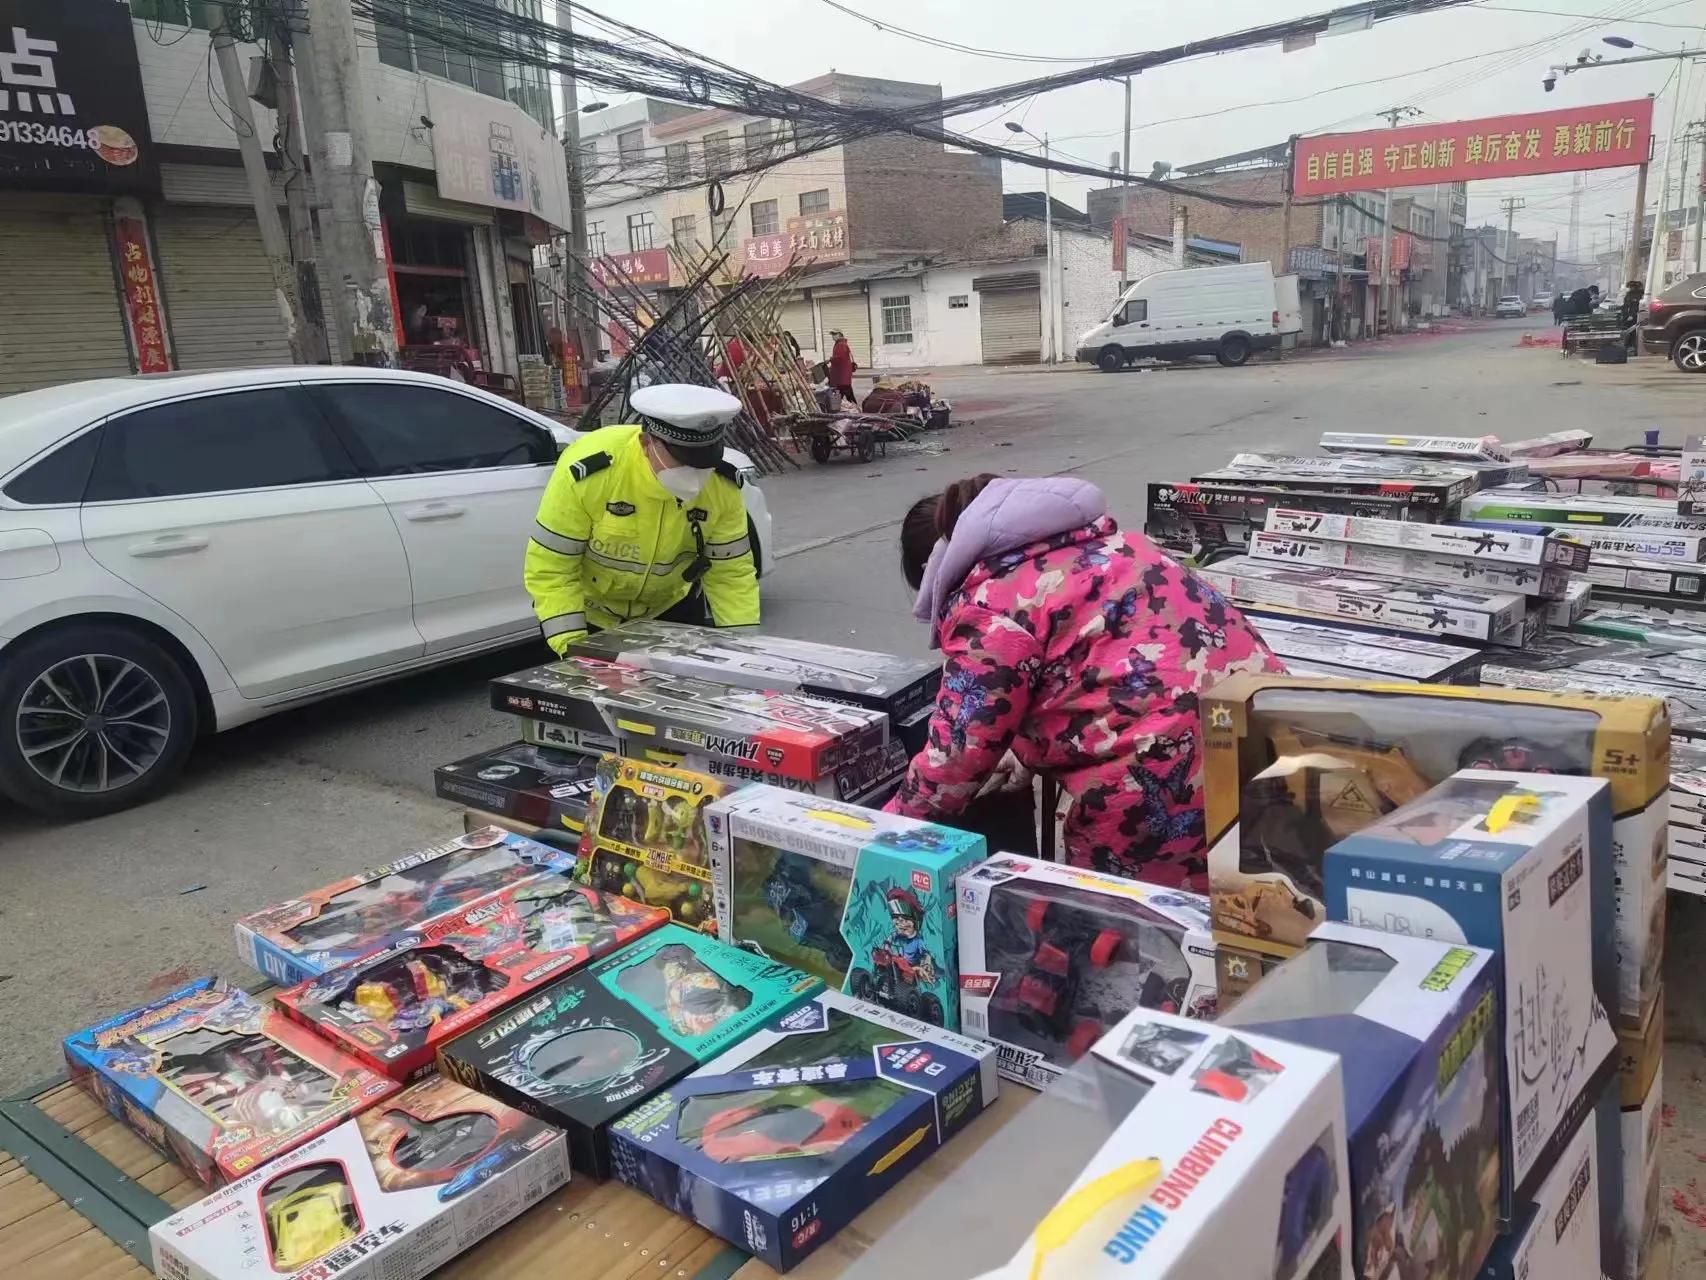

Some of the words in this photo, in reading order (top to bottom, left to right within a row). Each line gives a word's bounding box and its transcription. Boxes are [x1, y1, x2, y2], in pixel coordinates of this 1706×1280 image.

[0, 26, 76, 115] 点
[1306, 148, 1374, 182] 自信自强
[1383, 138, 1457, 175] 守正创新
[1465, 128, 1542, 165] 踔厉奋发
[1552, 117, 1638, 158] 勇毅前行
[1177, 490, 1214, 505] AK47
[704, 733, 763, 763] AWM
[1602, 749, 1640, 766] 5+
[708, 760, 764, 783] 突击步枪
[768, 774, 816, 794] M416
[711, 841, 725, 852] 6+
[912, 873, 930, 886] R/C
[964, 976, 992, 989] 合金版
[640, 1122, 671, 1143] 1:16
[1150, 1117, 1244, 1210] CLIMBING
[791, 1201, 820, 1232] 1:16
[1102, 1203, 1169, 1265] KING
